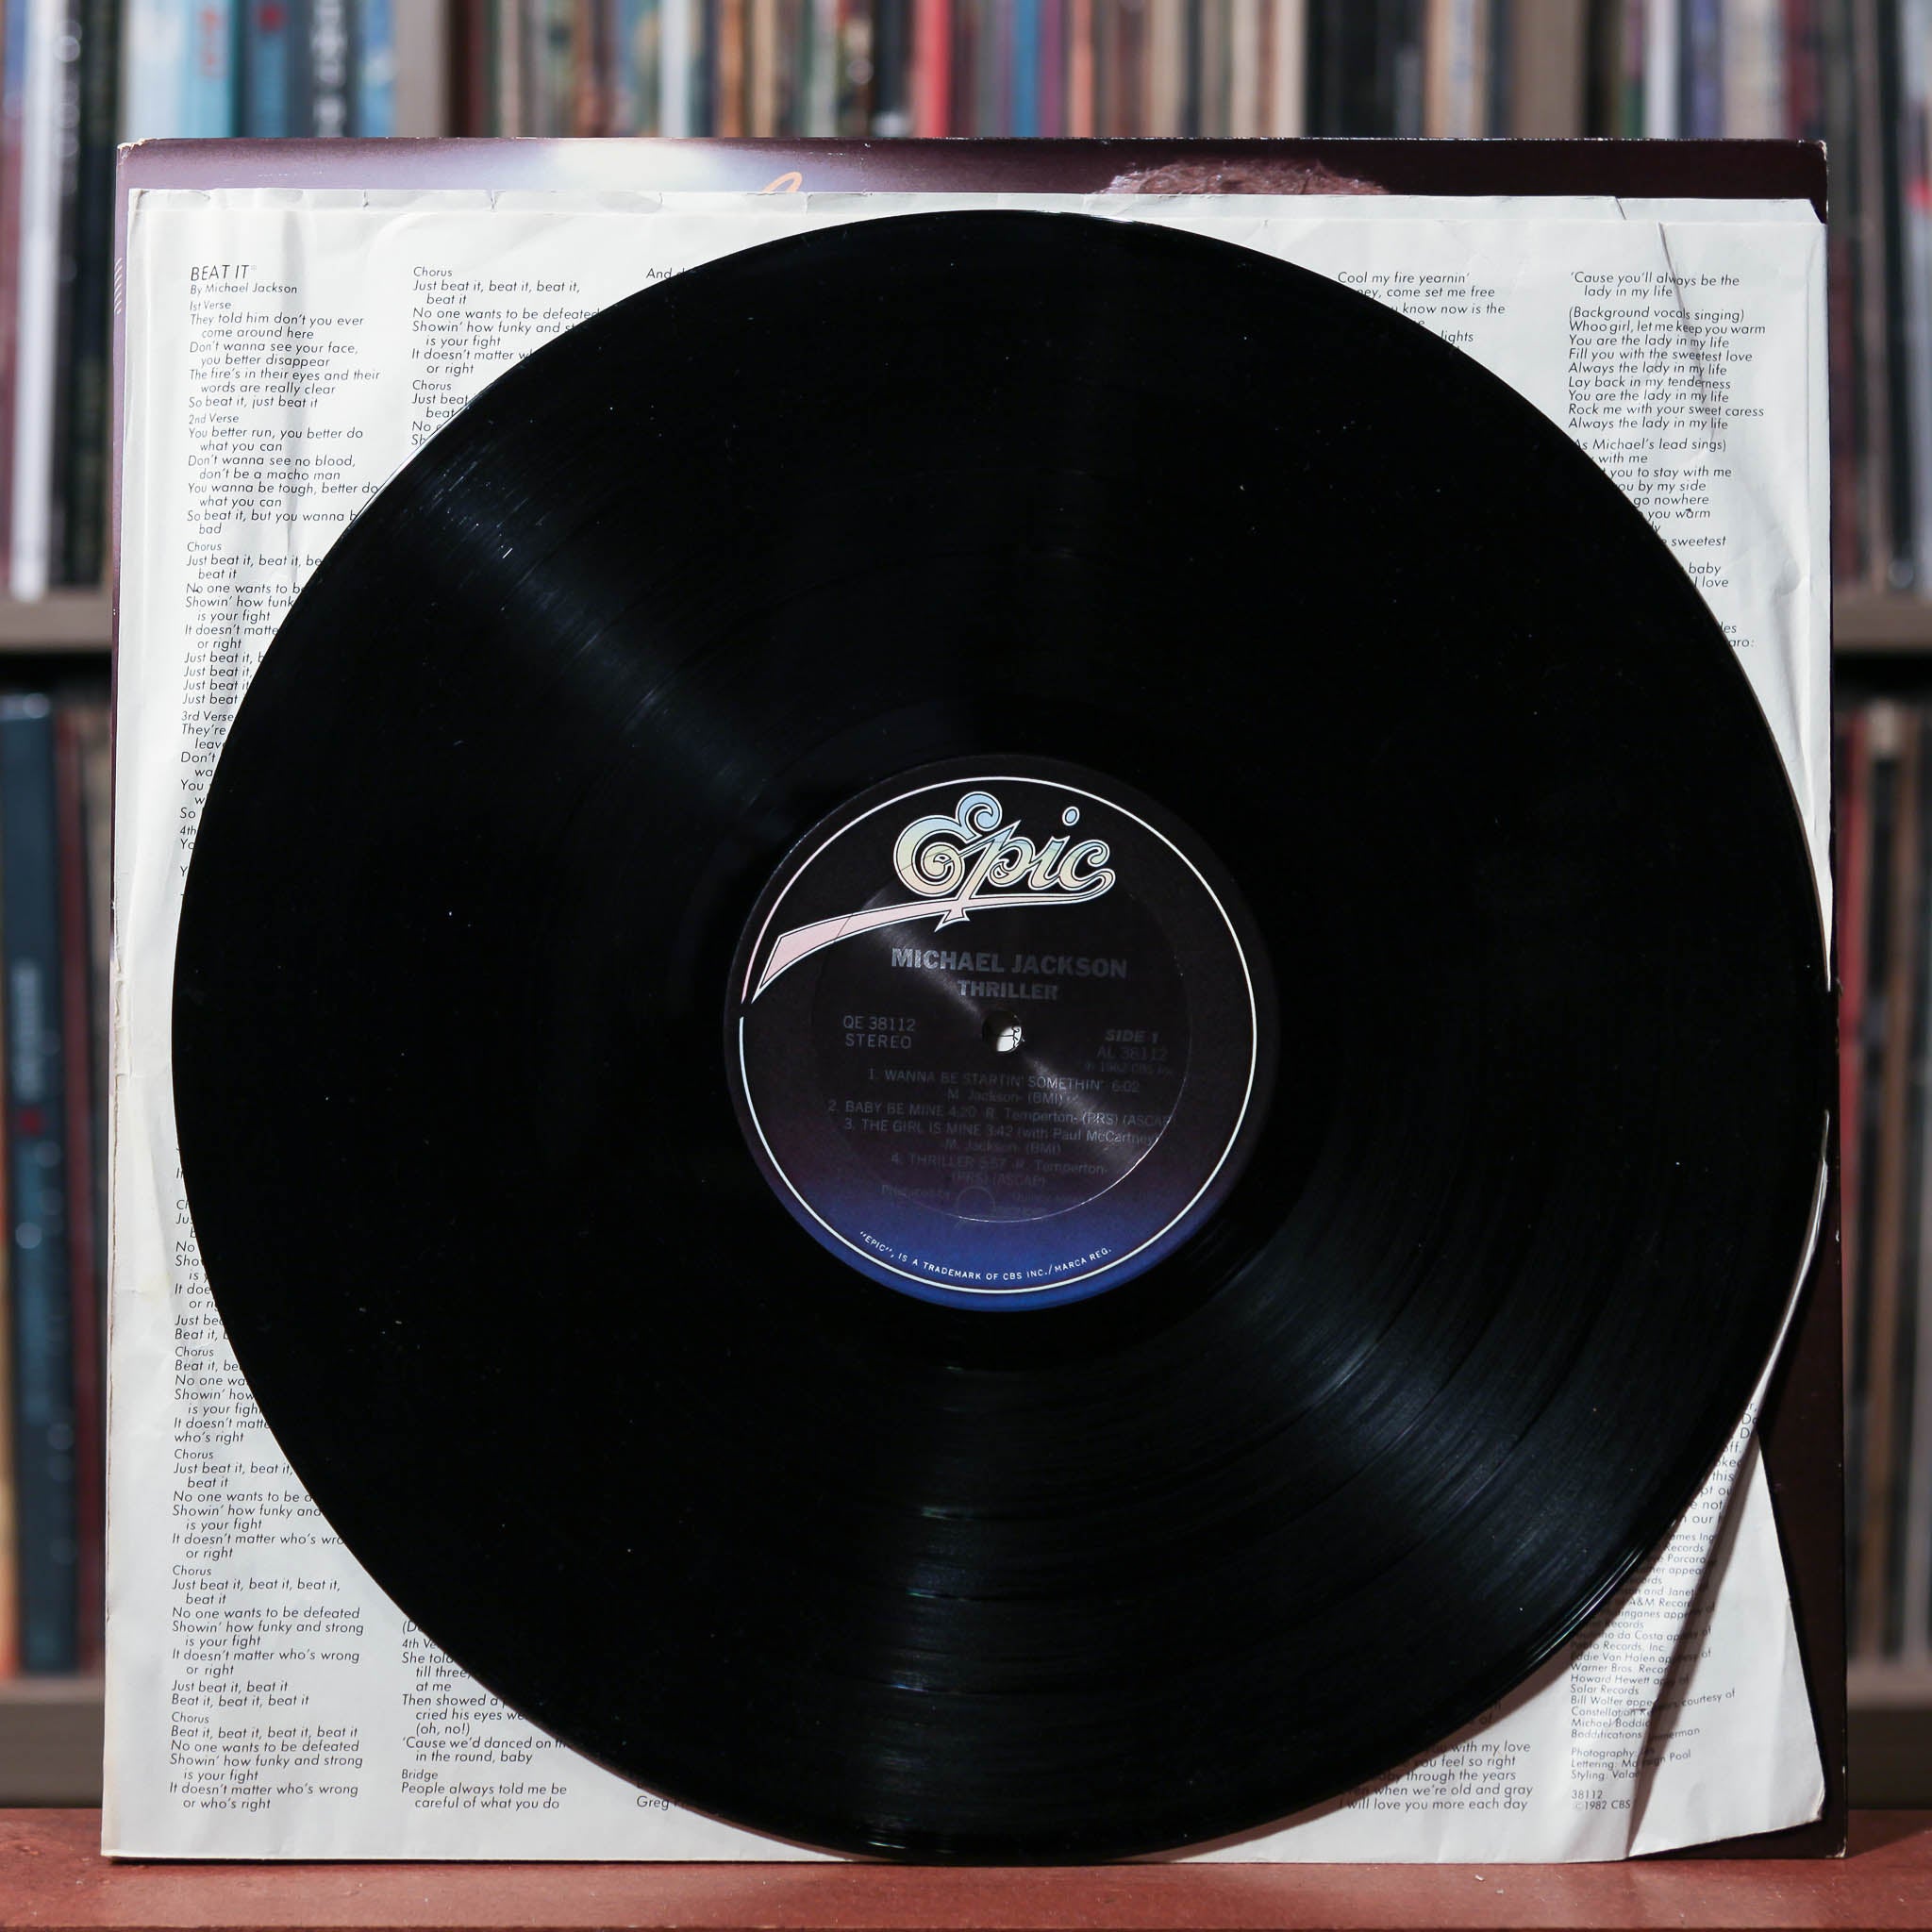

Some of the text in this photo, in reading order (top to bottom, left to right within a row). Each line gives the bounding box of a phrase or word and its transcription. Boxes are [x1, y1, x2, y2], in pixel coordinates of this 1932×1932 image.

[191, 265, 230, 281] BEAT
[413, 266, 452, 277] Chorus
[646, 268, 673, 278] And
[1338, 272, 1469, 286] Cool my fire yearnin'
[413, 279, 579, 293] Just beat it, beat it, beat it,
[1572, 272, 1740, 288] 'Cause you'll always be the
[191, 282, 297, 295] By Michael Jackson
[1387, 289, 1421, 297] come
[1424, 287, 1443, 297] set
[1472, 285, 1494, 297] free
[1585, 285, 1611, 299] lady
[1632, 289, 1649, 299] my
[1654, 285, 1672, 297] life
[204, 300, 232, 309] Verse
[426, 292, 466, 305] beat it
[191, 313, 214, 326] They
[219, 313, 242, 324] told
[246, 313, 269, 323] him
[274, 313, 306, 325] don't
[309, 318, 332, 328] you
[1570, 306, 1743, 324] (Background vocals singing)
[238, 326, 282, 338] around
[287, 326, 313, 340] here
[191, 341, 219, 353] Don't
[270, 343, 292, 352] see
[295, 343, 324, 356] your
[328, 341, 358, 354] face,
[182, 710, 234, 721] 3rd Verse
[183, 723, 225, 738] They're
[181, 752, 215, 762] Don't
[181, 779, 204, 791] You
[893, 791, 1116, 932] Epic
[891, 948, 1127, 978] MICHAEL JACKSON
[957, 979, 1058, 1000] THRILLER
[842, 1015, 916, 1033] QE 38112
[844, 1033, 912, 1049] STEREO
[1105, 1028, 1147, 1042] SIDE
[884, 1069, 936, 1084] WANNA
[941, 1071, 959, 1085] BE
[844, 1100, 882, 1114] BABY
[887, 1102, 905, 1115] BE
[908, 1103, 944, 1118] MINE
[861, 1118, 889, 1132] THE
[892, 1120, 923, 1134] GIRL
[929, 1122, 942, 1135] IS
[945, 1124, 981, 1137] MINE
[1053, 1126, 1082, 1141] Paul
[898, 1252, 908, 1262] IS
[923, 1262, 981, 1280] TRADEMARK
[1003, 1272, 1022, 1280] CBS
[1089, 1248, 1112, 1260] REG.
[175, 1449, 213, 1459] Chorus
[173, 1607, 191, 1619] No
[225, 1607, 261, 1618] wants
[266, 1607, 278, 1617] to
[283, 1607, 298, 1618] be
[304, 1607, 359, 1619] defeated
[173, 1621, 363, 1636] Showin' how funky and strong
[186, 1635, 260, 1651] is your fight
[1481, 1740, 1530, 1756] my love
[402, 1769, 438, 1782] Bridge
[402, 1782, 444, 1796] People
[449, 1783, 493, 1797] always
[499, 1783, 524, 1794] told
[551, 1783, 566, 1794] be
[201, 1797, 236, 1808] who's
[242, 1797, 270, 1812] right
[415, 1796, 558, 1811] careful of what you do
[637, 1796, 669, 1811] Greg
[1374, 1798, 1527, 1811] love you more each day
